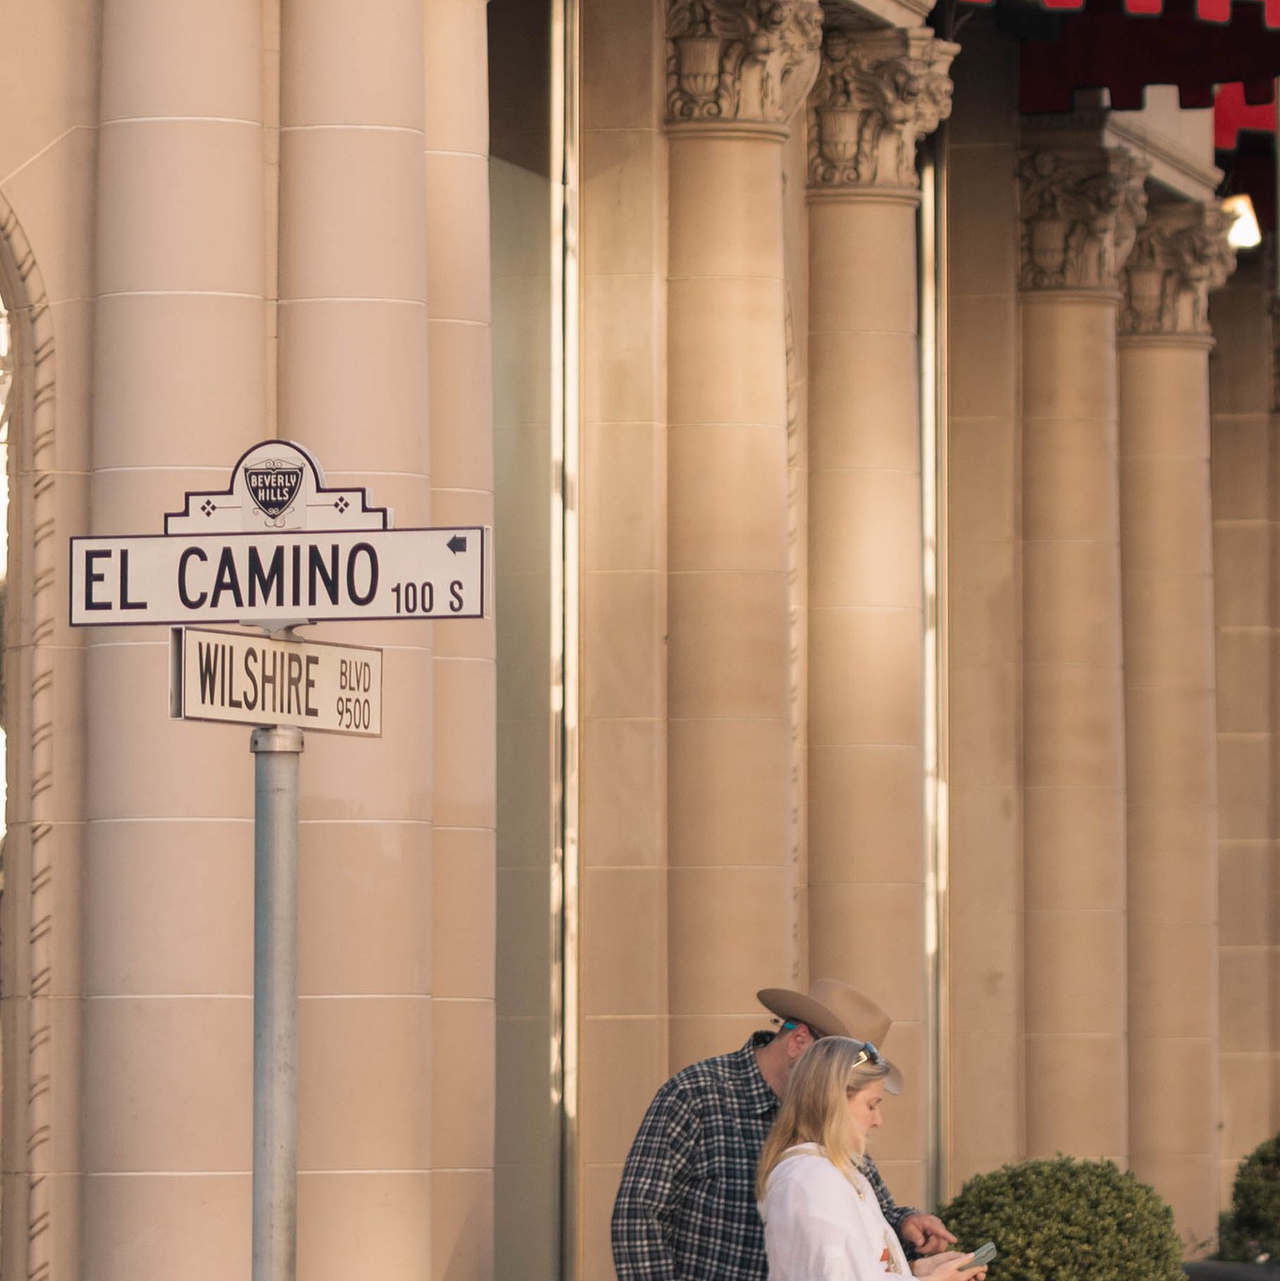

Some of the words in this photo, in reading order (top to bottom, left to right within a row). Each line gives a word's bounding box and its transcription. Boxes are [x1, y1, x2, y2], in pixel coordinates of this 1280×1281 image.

[251, 474, 297, 487] BEVERLY
[258, 488, 289, 500] HILLS
[85, 549, 148, 611] EL
[178, 542, 379, 609] CAMINO
[391, 581, 434, 614] 100
[449, 580, 464, 612] S
[198, 641, 319, 717] WILSHIRE
[339, 659, 371, 693] BLVD
[336, 696, 371, 730] 9500
